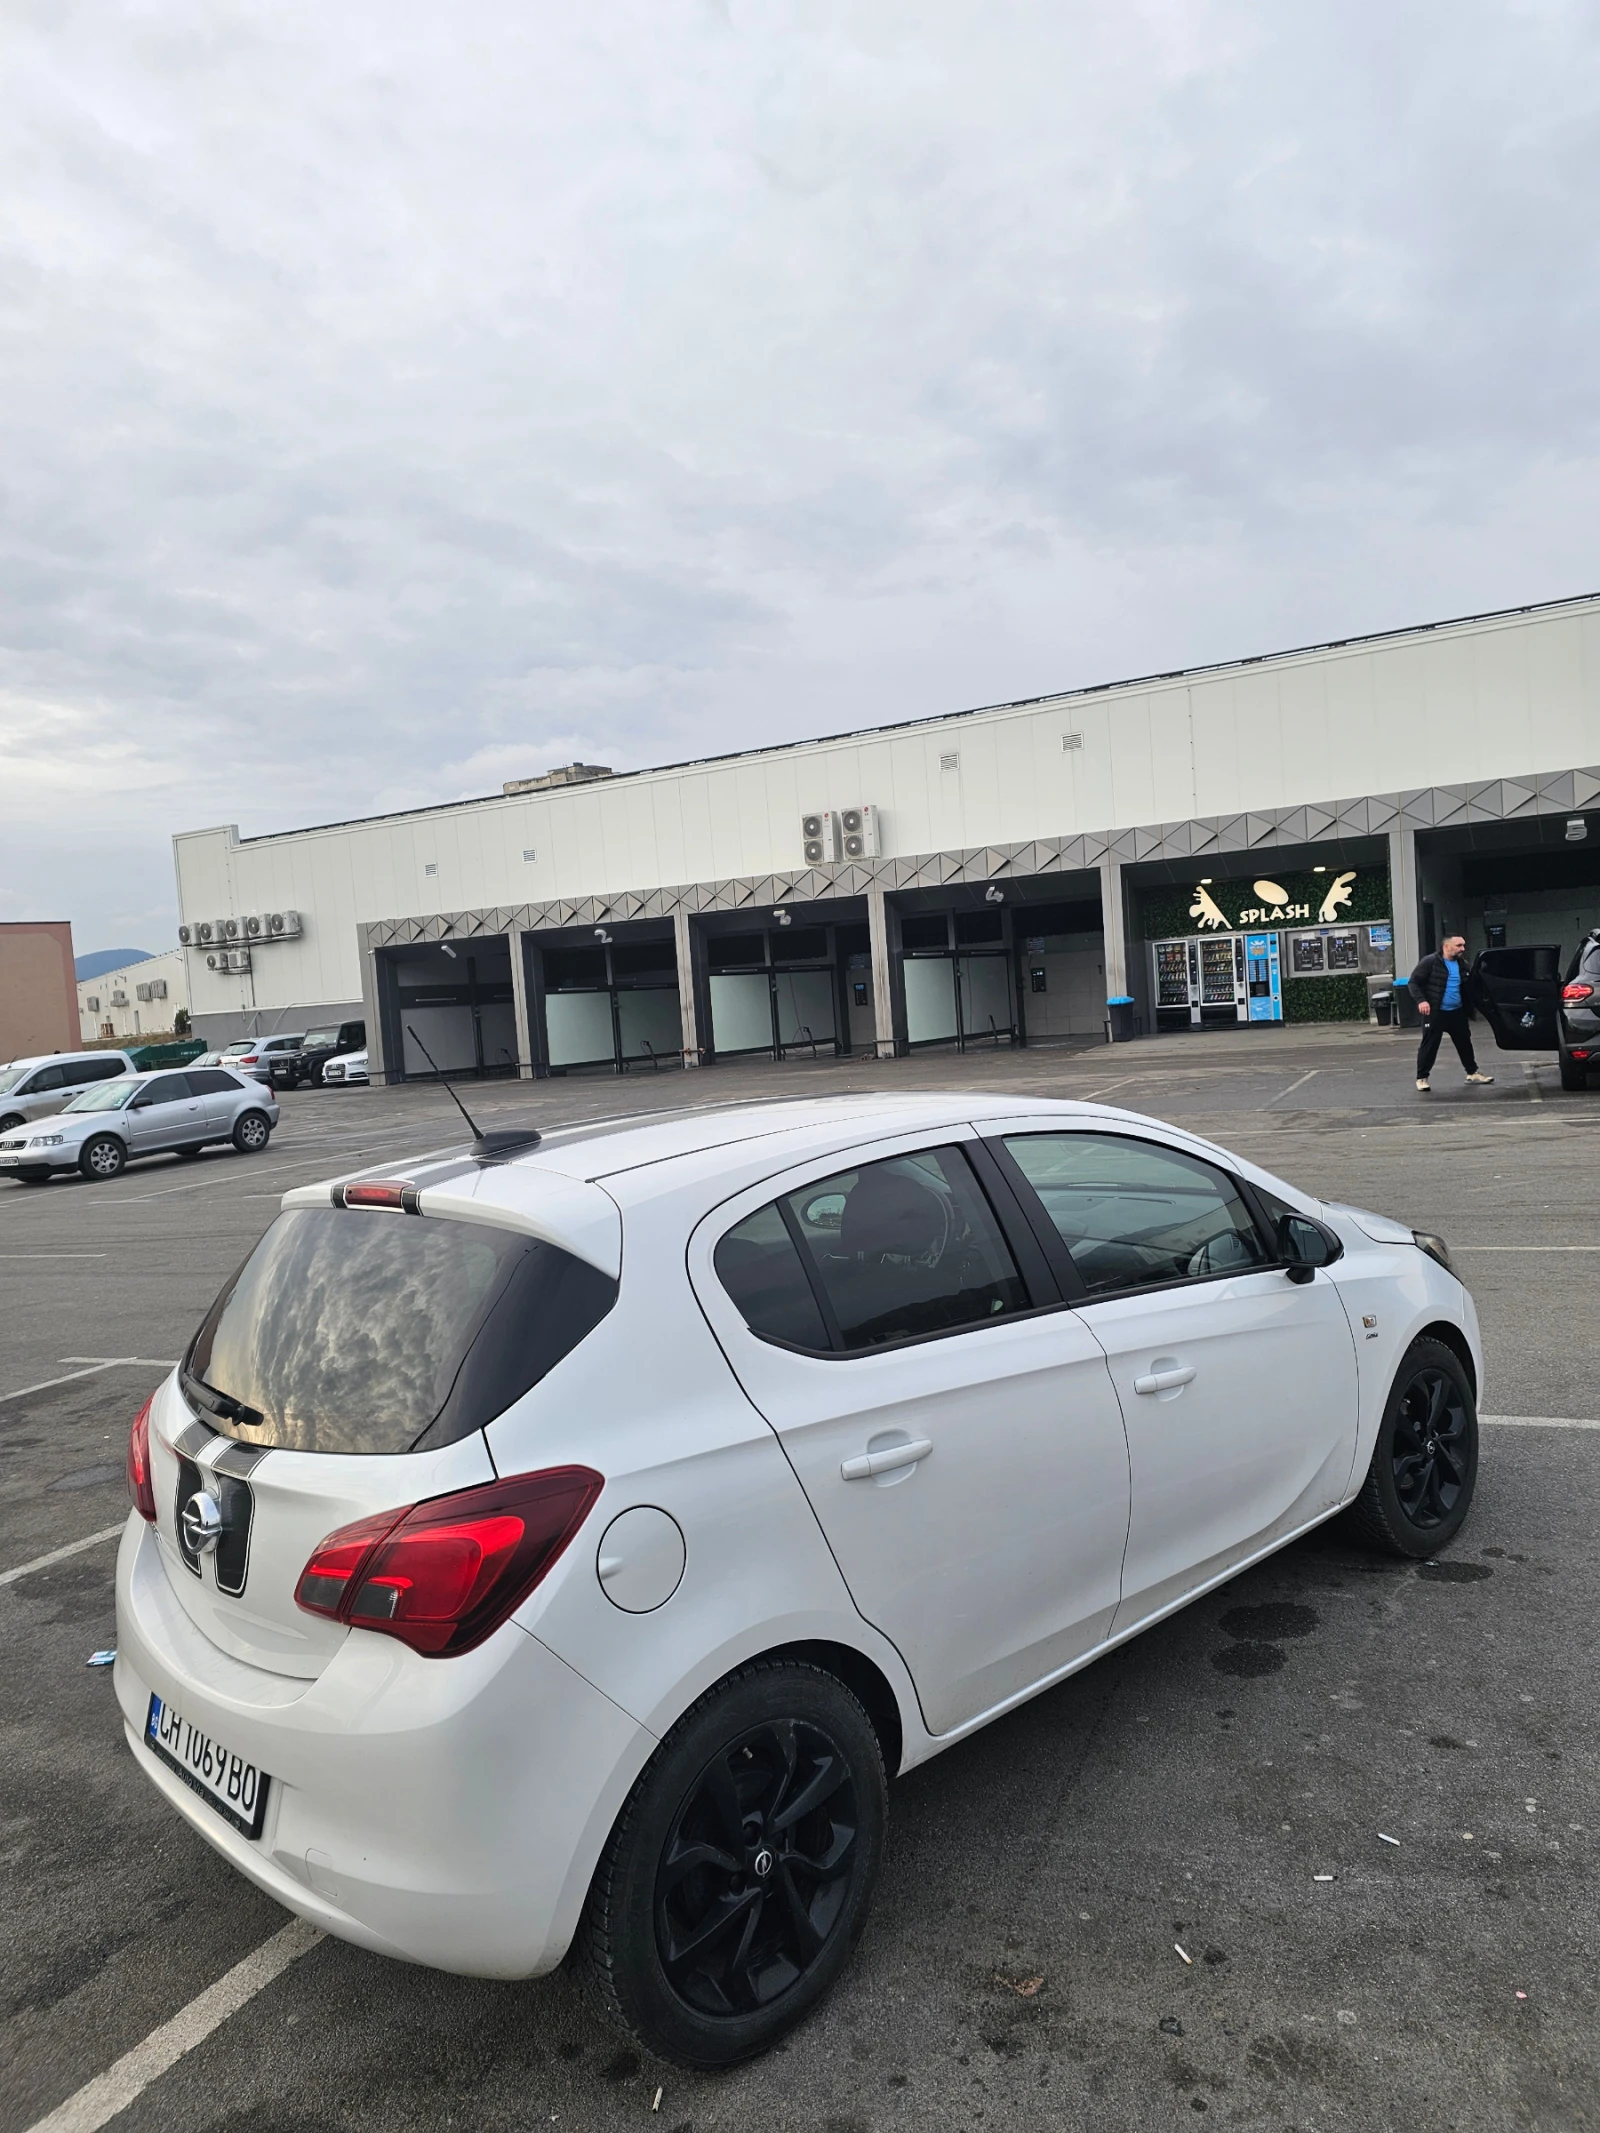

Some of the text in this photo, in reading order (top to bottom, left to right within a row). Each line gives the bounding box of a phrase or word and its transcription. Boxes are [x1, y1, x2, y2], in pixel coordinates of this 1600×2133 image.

[1565, 819, 1588, 841] 5
[985, 886, 1004, 902] 4
[1240, 904, 1309, 924] SPLASH
[594, 929, 613, 943] 2
